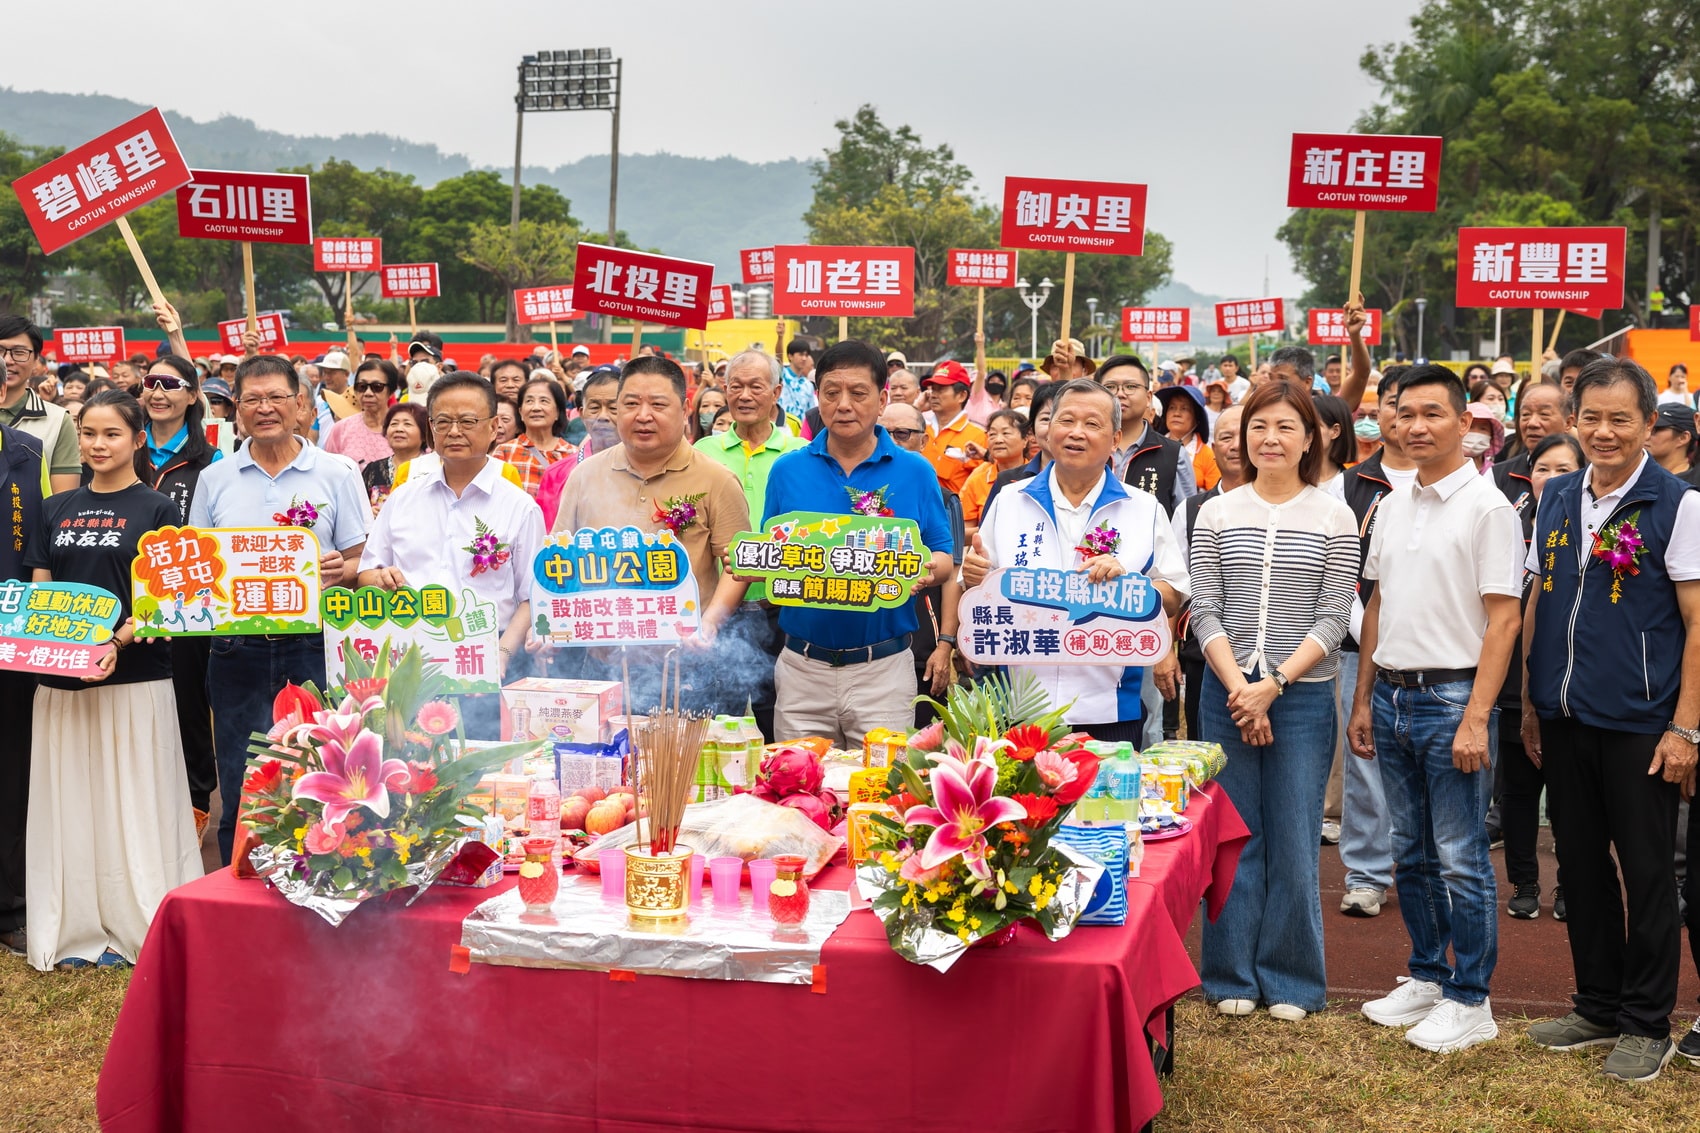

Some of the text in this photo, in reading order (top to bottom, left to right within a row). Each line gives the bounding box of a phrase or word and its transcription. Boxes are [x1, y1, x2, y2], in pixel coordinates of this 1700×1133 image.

[31, 129, 166, 223] 碧峰里
[1303, 147, 1426, 189] 新庄里
[67, 179, 157, 231] CAOTUN TOWNSHIP
[187, 183, 296, 223] 石川里
[1317, 192, 1408, 203] CAOTUN TOWNSHIP
[204, 224, 284, 236] CAOTUN TOWNSHIP
[1028, 233, 1115, 246] CAOTUN TOWNSHIP
[1472, 242, 1608, 283] 新豐里
[586, 259, 698, 309] 北投里
[786, 258, 901, 295] 加老里
[801, 299, 886, 309] CAOTUN TOWNSHIP
[1489, 290, 1590, 300] CAOTUN TOWNSHIP
[598, 300, 681, 319] CAOTUN TOWNSHIP
[59, 517, 127, 529] 南投縣議員
[54, 530, 122, 547] 林友友
[231, 534, 304, 553] 歡迎大家
[577, 531, 639, 550] 草屯鎮
[1033, 522, 1045, 557] 副縣長
[145, 537, 201, 568] 活力
[240, 555, 296, 573] 一起來
[736, 542, 921, 577] 優化草屯 爭取升市
[1543, 530, 1559, 592] 莊清南
[159, 560, 215, 591] 草屯
[544, 550, 678, 585] 中山公園
[235, 580, 303, 613] 運動
[878, 584, 899, 596] 草屯
[1010, 571, 1146, 613] 南投縣政府
[326, 589, 448, 619] 中山公園
[551, 595, 678, 618] 設施改善工程
[972, 606, 1014, 625] 縣長
[24, 613, 93, 641] 好地方
[465, 609, 488, 632] 讚
[574, 619, 658, 640] 竣工典禮
[973, 629, 1060, 656] 許淑華
[1070, 635, 1155, 651] 補助經費
